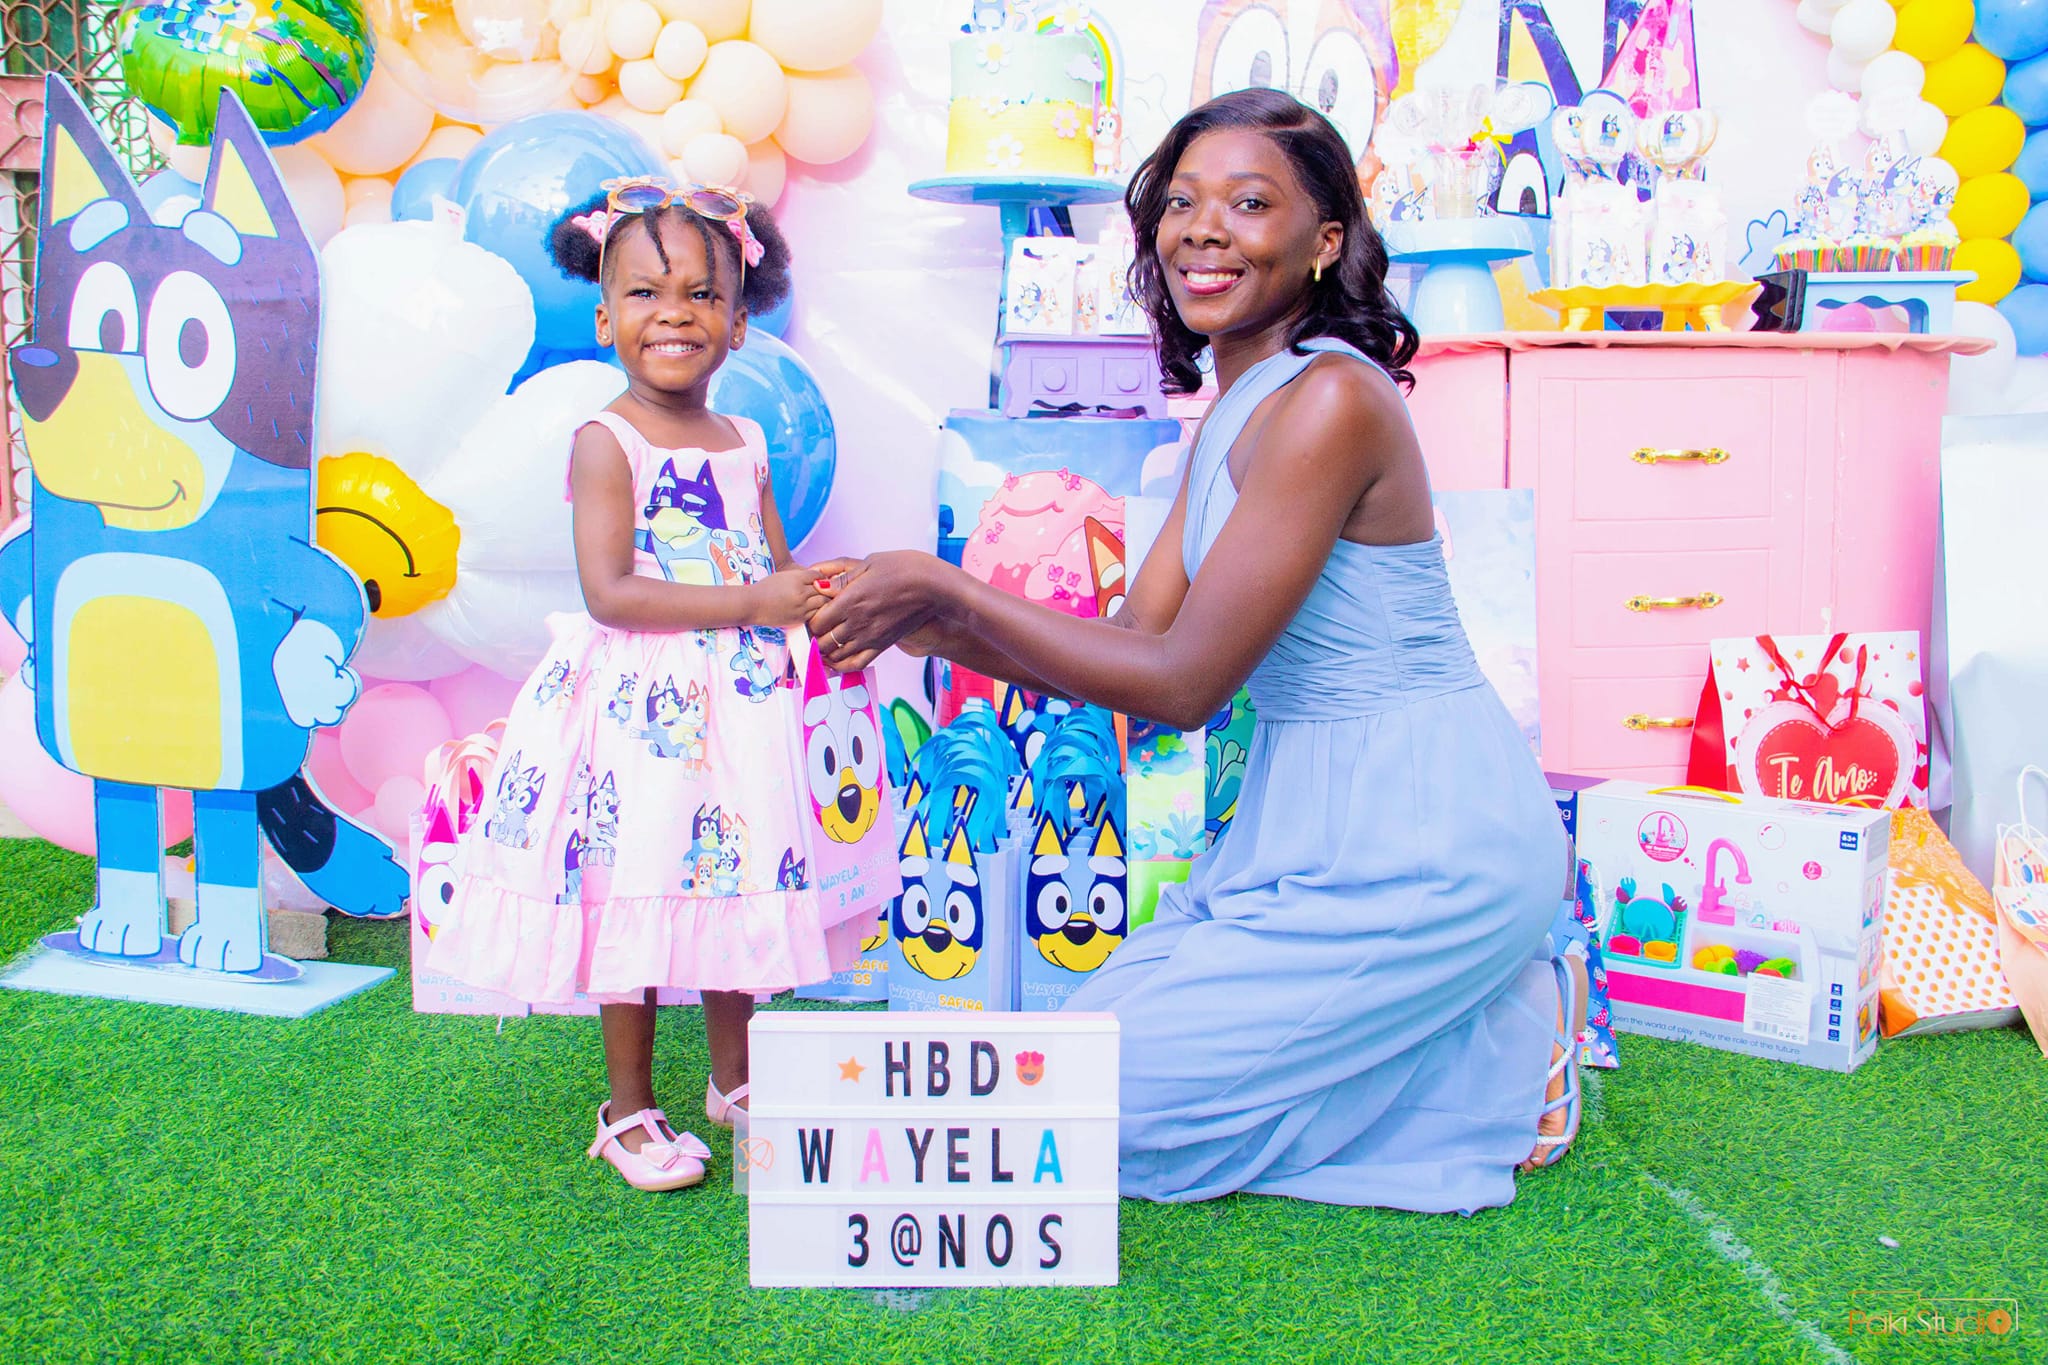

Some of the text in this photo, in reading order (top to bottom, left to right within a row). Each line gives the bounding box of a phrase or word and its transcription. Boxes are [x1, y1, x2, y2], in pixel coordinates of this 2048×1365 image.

[1770, 756, 1803, 799] Te
[819, 864, 860, 892] WAYELA
[839, 891, 848, 907] 3
[439, 991, 448, 1003] 3
[890, 983, 937, 1005] WAYELA
[938, 992, 984, 1012] SAFIRA
[1047, 997, 1058, 1011] 3
[1630, 1016, 1643, 1026] the
[1644, 1020, 1667, 1031] world
[1667, 1023, 1677, 1033] of
[1677, 1025, 1694, 1037] play
[1699, 1029, 1801, 1055] Play the role of the future
[884, 1040, 1000, 1097] HBD
[798, 1127, 1063, 1184] WAYELA
